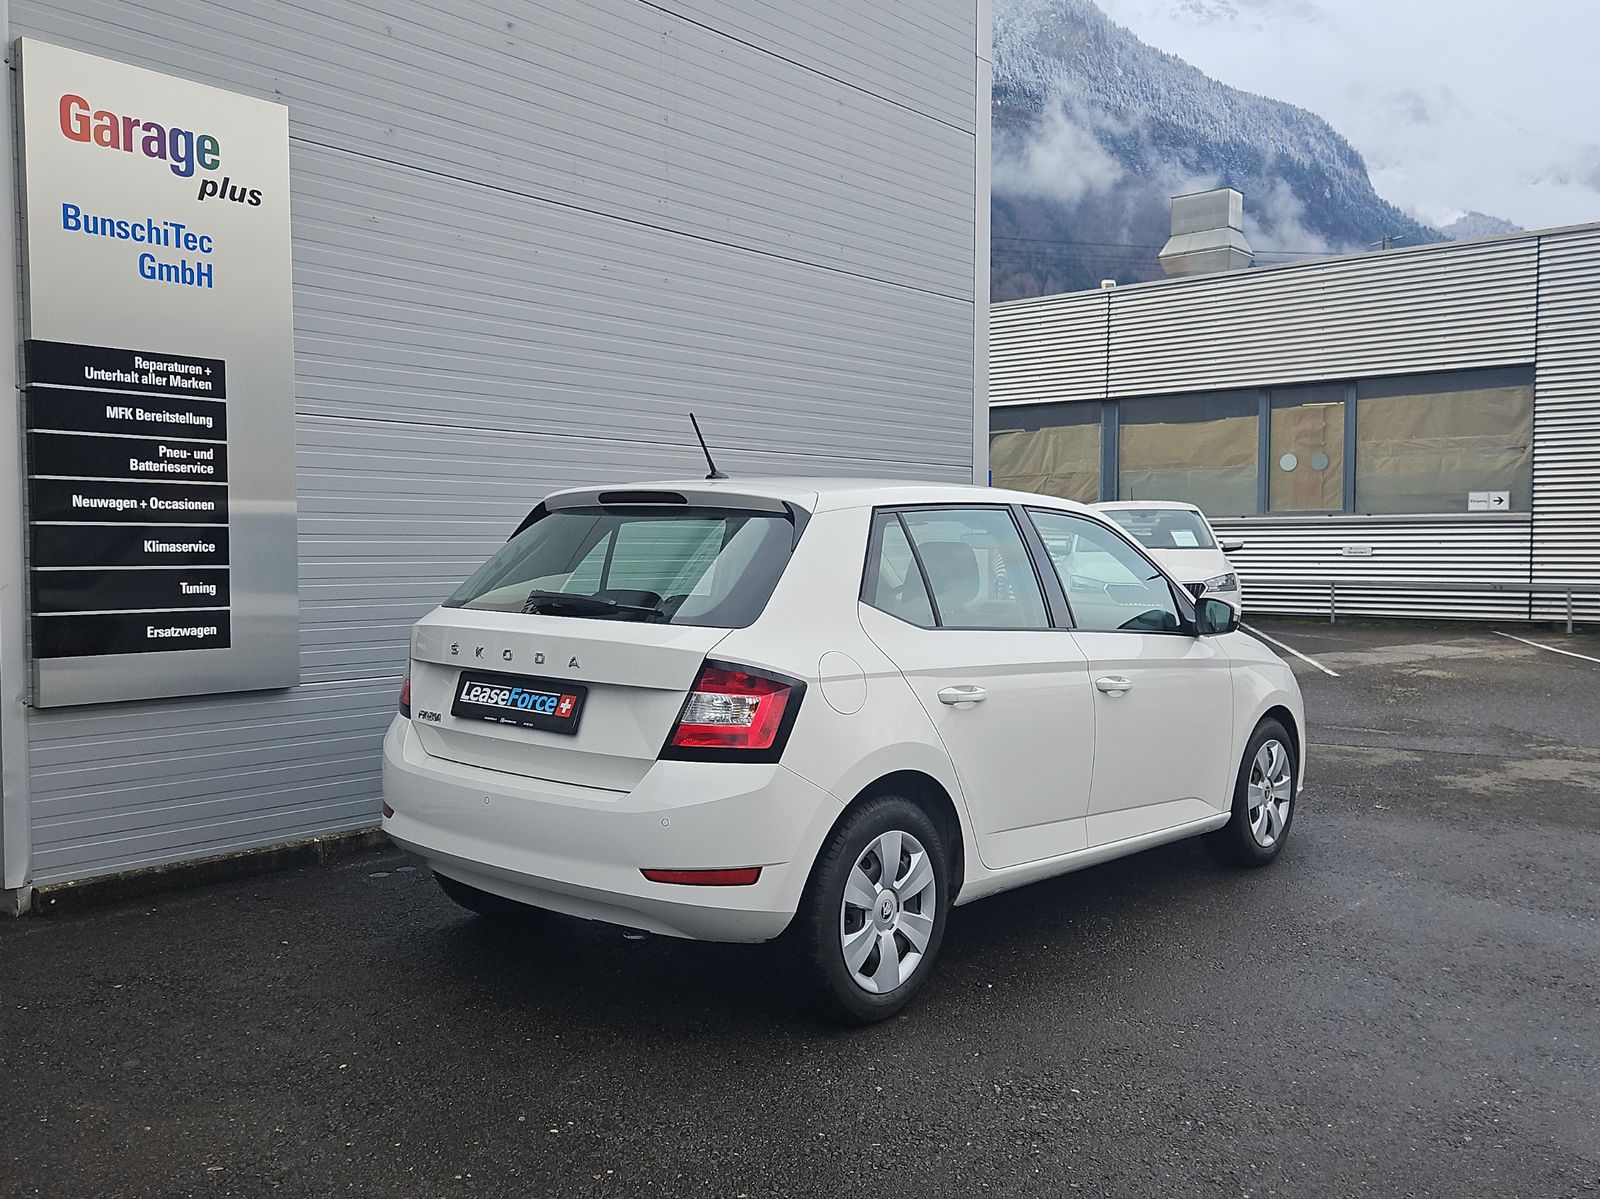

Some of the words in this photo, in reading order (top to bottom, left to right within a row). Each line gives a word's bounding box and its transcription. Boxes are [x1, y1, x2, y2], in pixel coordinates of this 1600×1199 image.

[59, 93, 220, 177] Garage
[197, 177, 263, 207] plus
[62, 202, 213, 254] BunschiTec
[138, 252, 213, 289] GmbH
[134, 356, 203, 375] Reparaturen
[84, 366, 140, 384] Unterhalt
[141, 373, 167, 387] aller
[169, 375, 212, 391] Marken
[106, 405, 133, 420] MFK
[135, 408, 213, 428] Bereitstellung
[158, 445, 191, 460] Pneu-
[193, 448, 213, 460] und
[129, 458, 214, 475] Batterieservice
[72, 494, 138, 511] Neuwagen
[149, 497, 215, 511] Occasionen
[143, 540, 216, 553] Klimaservice
[179, 582, 217, 596] Tuning
[146, 625, 217, 639] Ersatzwagen
[460, 680, 559, 714] LeaseForce
